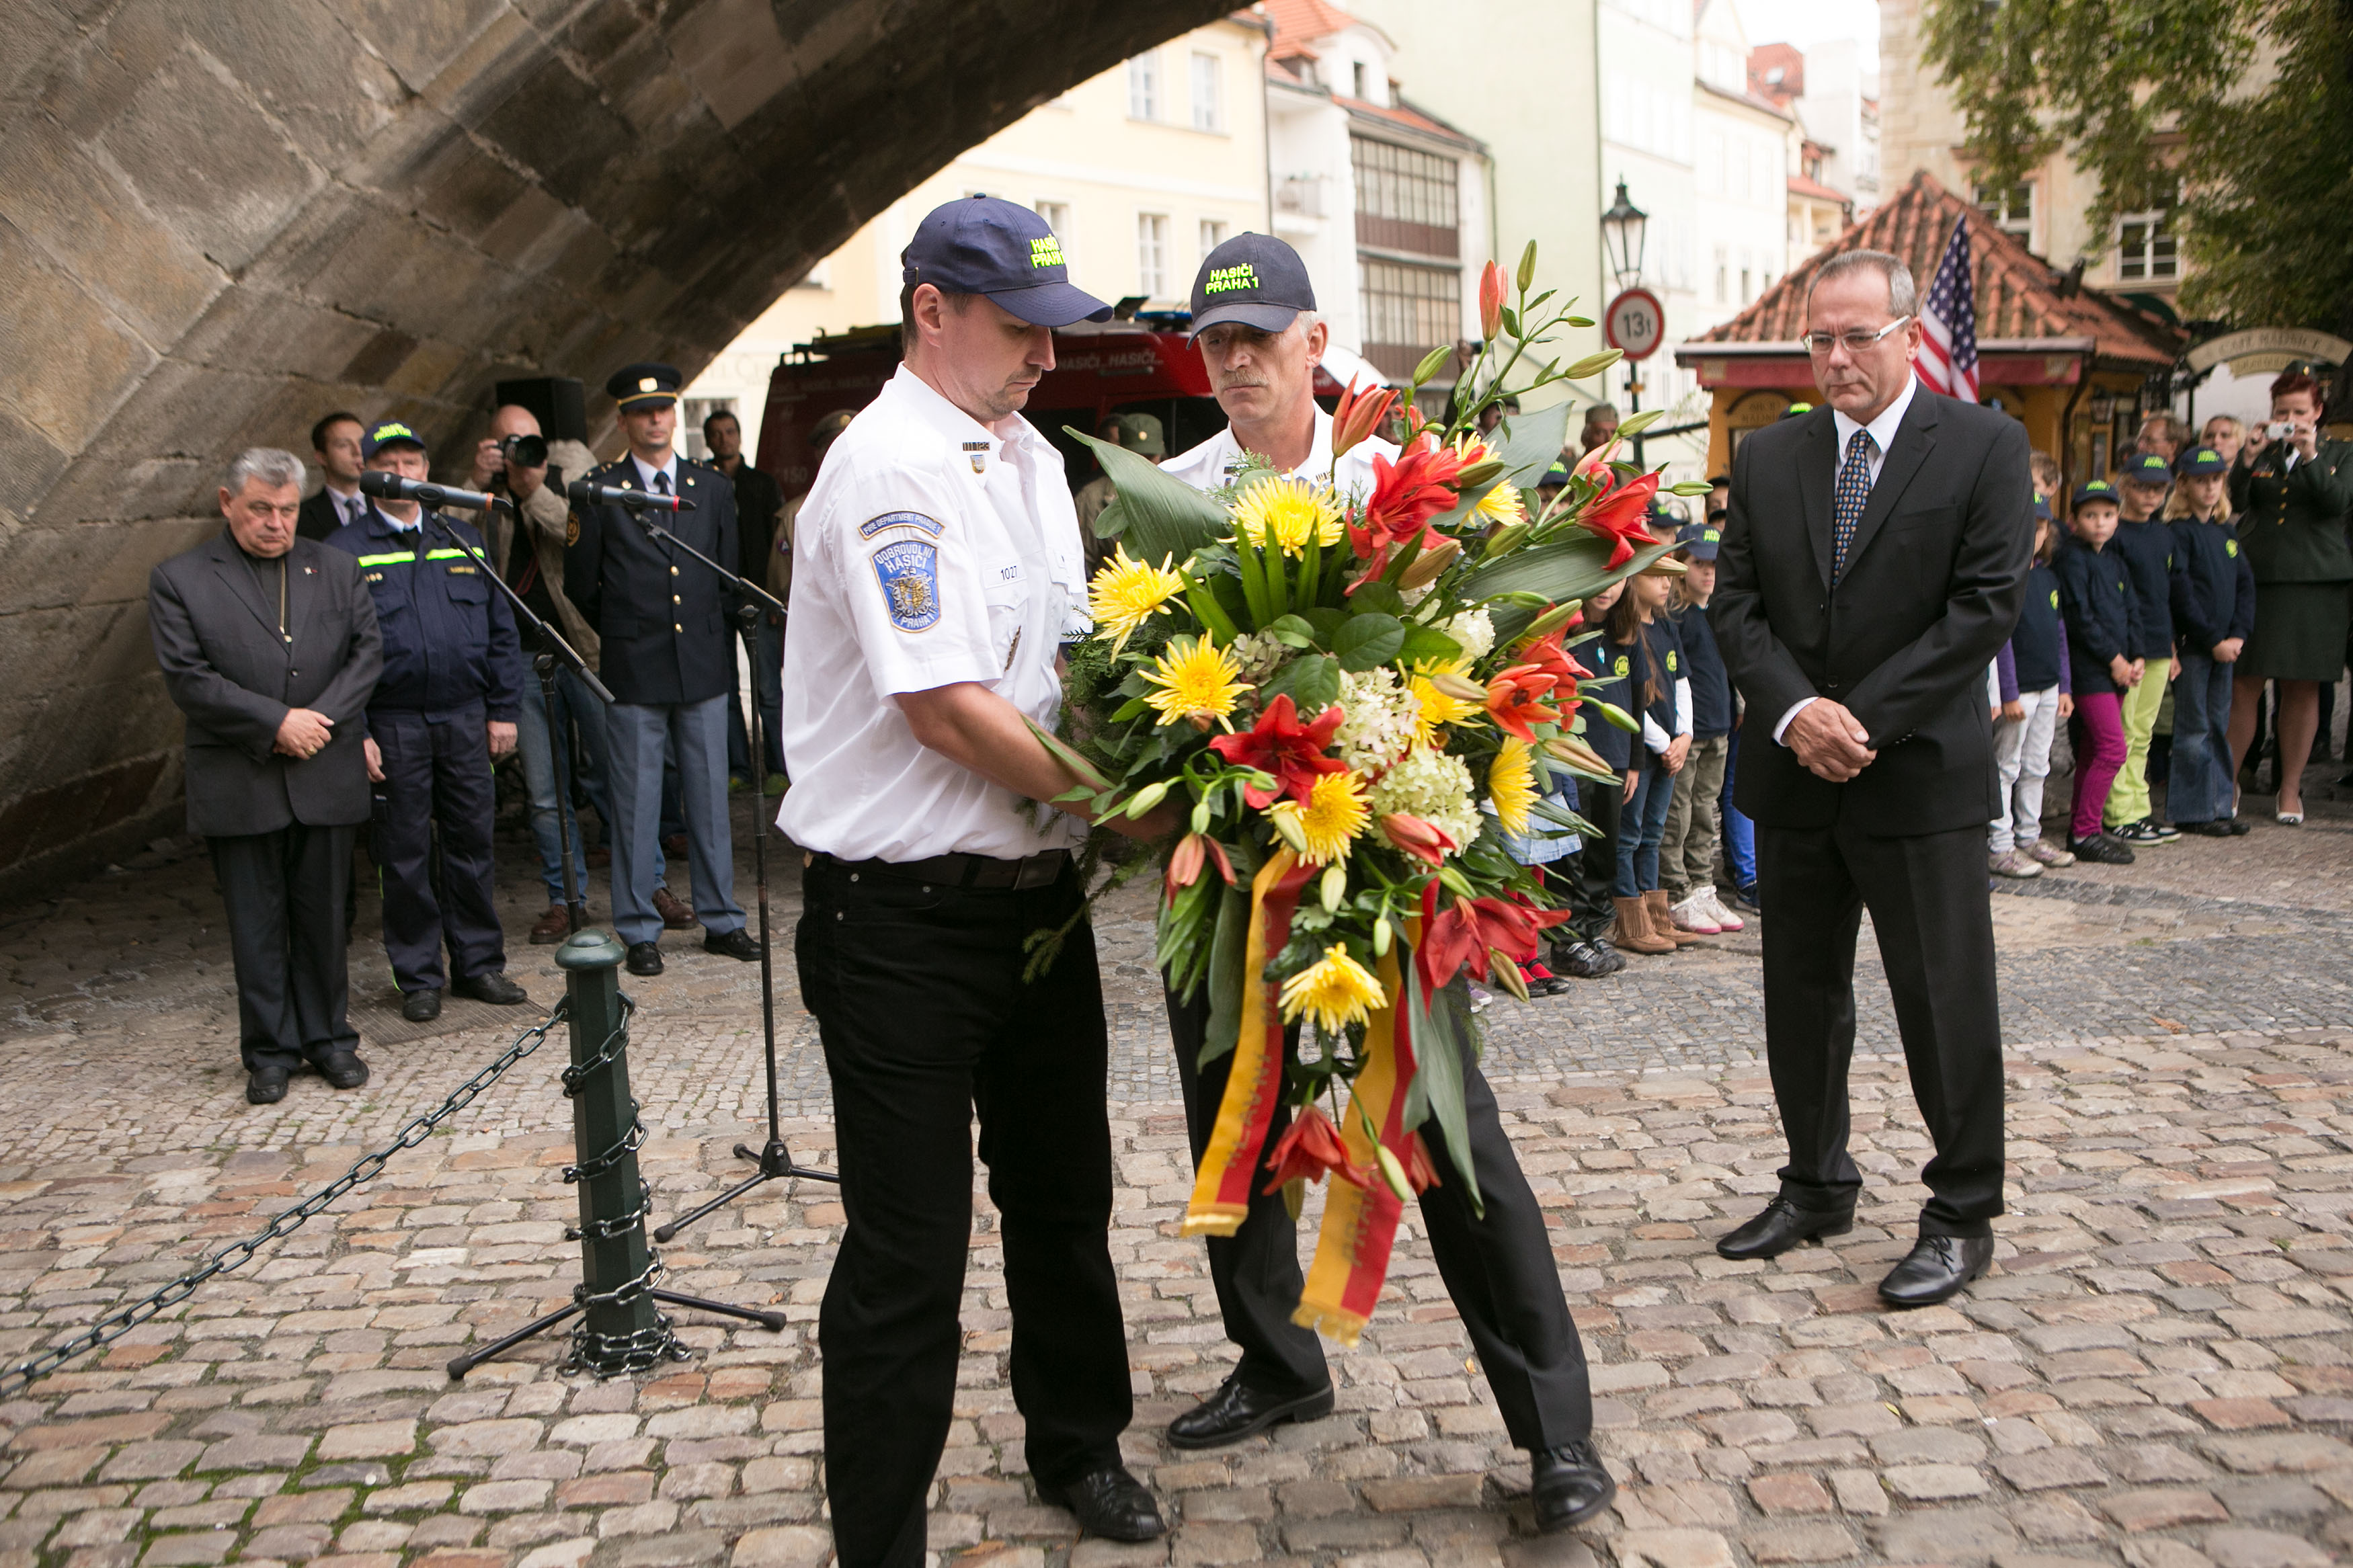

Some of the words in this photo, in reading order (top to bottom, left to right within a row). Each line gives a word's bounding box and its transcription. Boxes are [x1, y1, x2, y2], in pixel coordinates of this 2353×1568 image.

[1210, 263, 1253, 282] HASIČI
[1205, 278, 1251, 296] PRAHA
[1251, 276, 1259, 289] 1
[863, 522, 878, 535] FIRE
[876, 513, 915, 528] DEPARTMENT
[915, 514, 939, 532] PRAGUE
[1000, 565, 1017, 581] 1027
[900, 615, 931, 628] PRAHA
